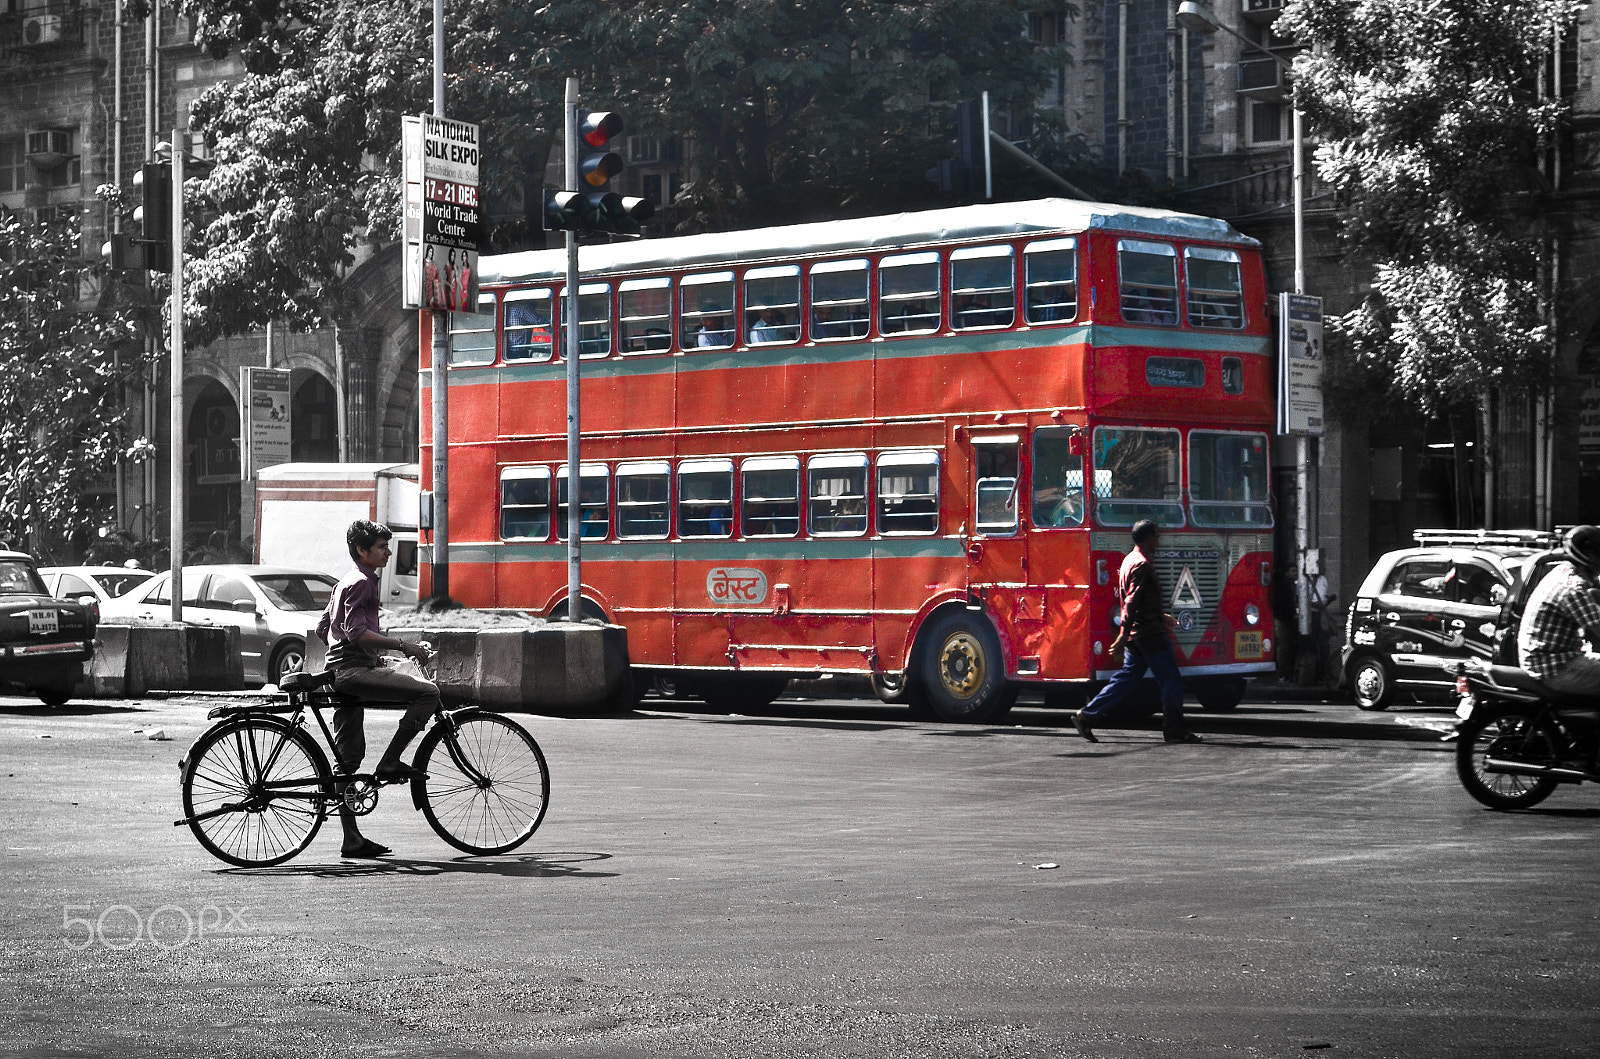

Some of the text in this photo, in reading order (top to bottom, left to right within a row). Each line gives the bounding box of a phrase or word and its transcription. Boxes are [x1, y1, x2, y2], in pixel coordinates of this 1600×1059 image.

[427, 117, 476, 145] NATIONAL
[425, 139, 477, 166] SILK EXPO
[425, 162, 479, 180] Exhibition & Sale
[425, 179, 436, 199] 17
[444, 182, 456, 203] 21
[458, 184, 478, 207] DEC.
[425, 201, 478, 224] World Trade
[437, 219, 466, 237] Centre
[712, 569, 760, 600] बेस्ट
